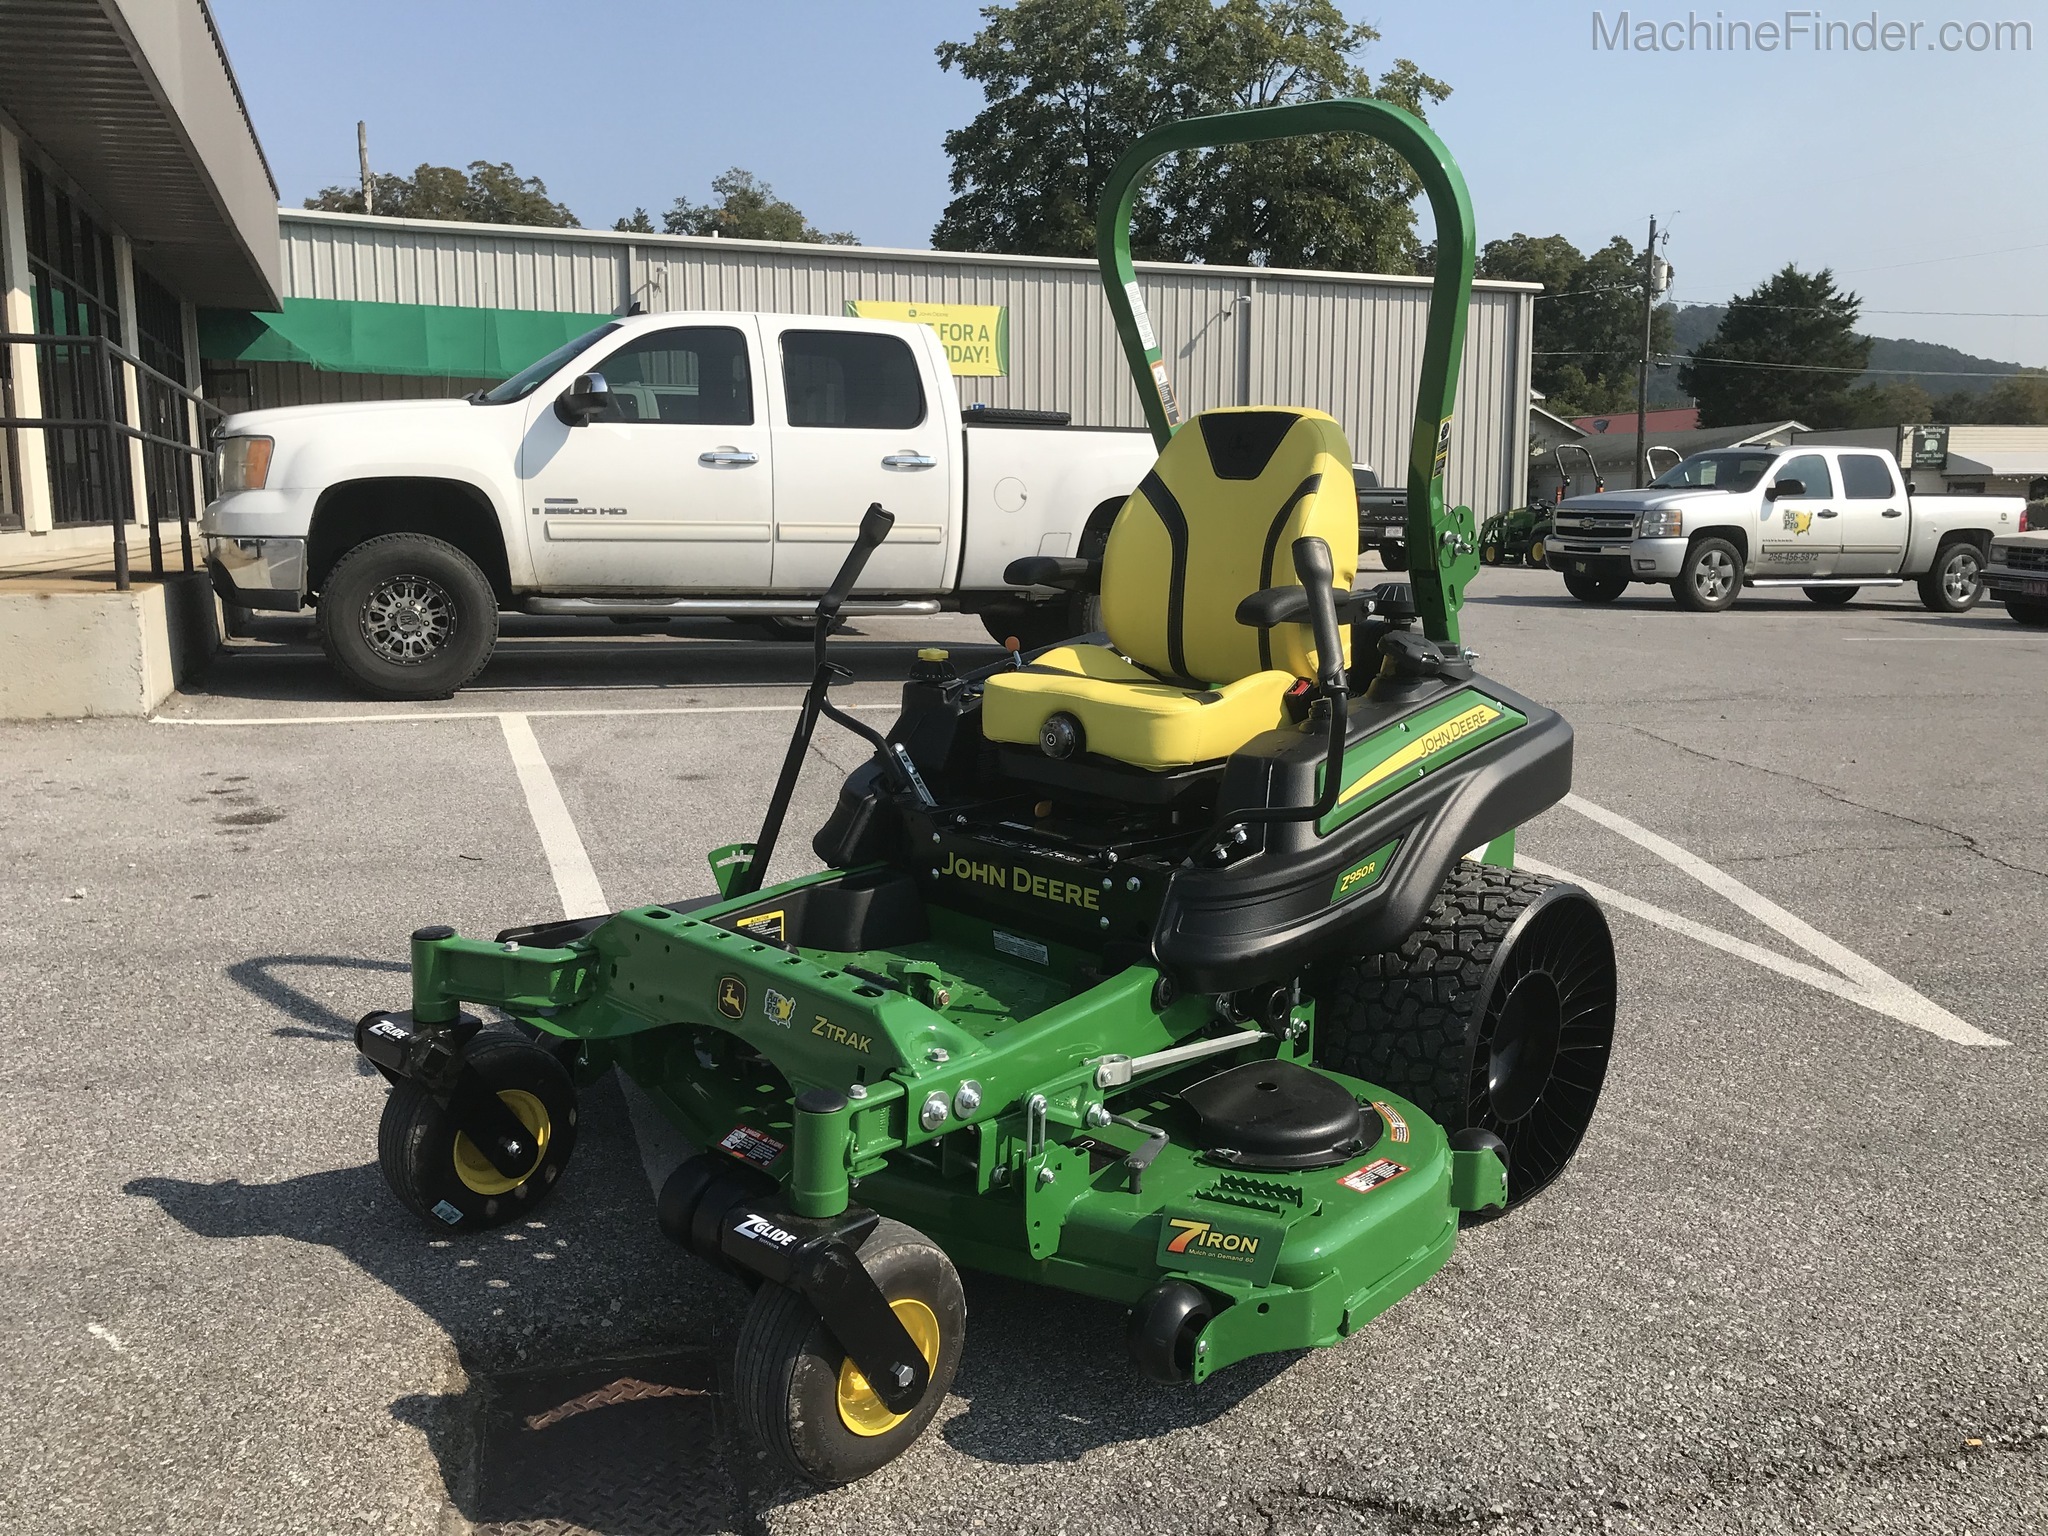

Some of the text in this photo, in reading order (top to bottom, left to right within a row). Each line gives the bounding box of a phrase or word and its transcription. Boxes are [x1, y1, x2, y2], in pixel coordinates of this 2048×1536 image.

[940, 323, 990, 342] FOR A
[1420, 710, 1487, 756] JOHN DEERE
[942, 852, 1100, 910] JOHN DEERE
[1340, 862, 1376, 892] Z950R
[812, 1015, 873, 1054] ZTRAK
[1188, 1248, 1206, 1256] Mulch
[1217, 1252, 1244, 1262] Demand
